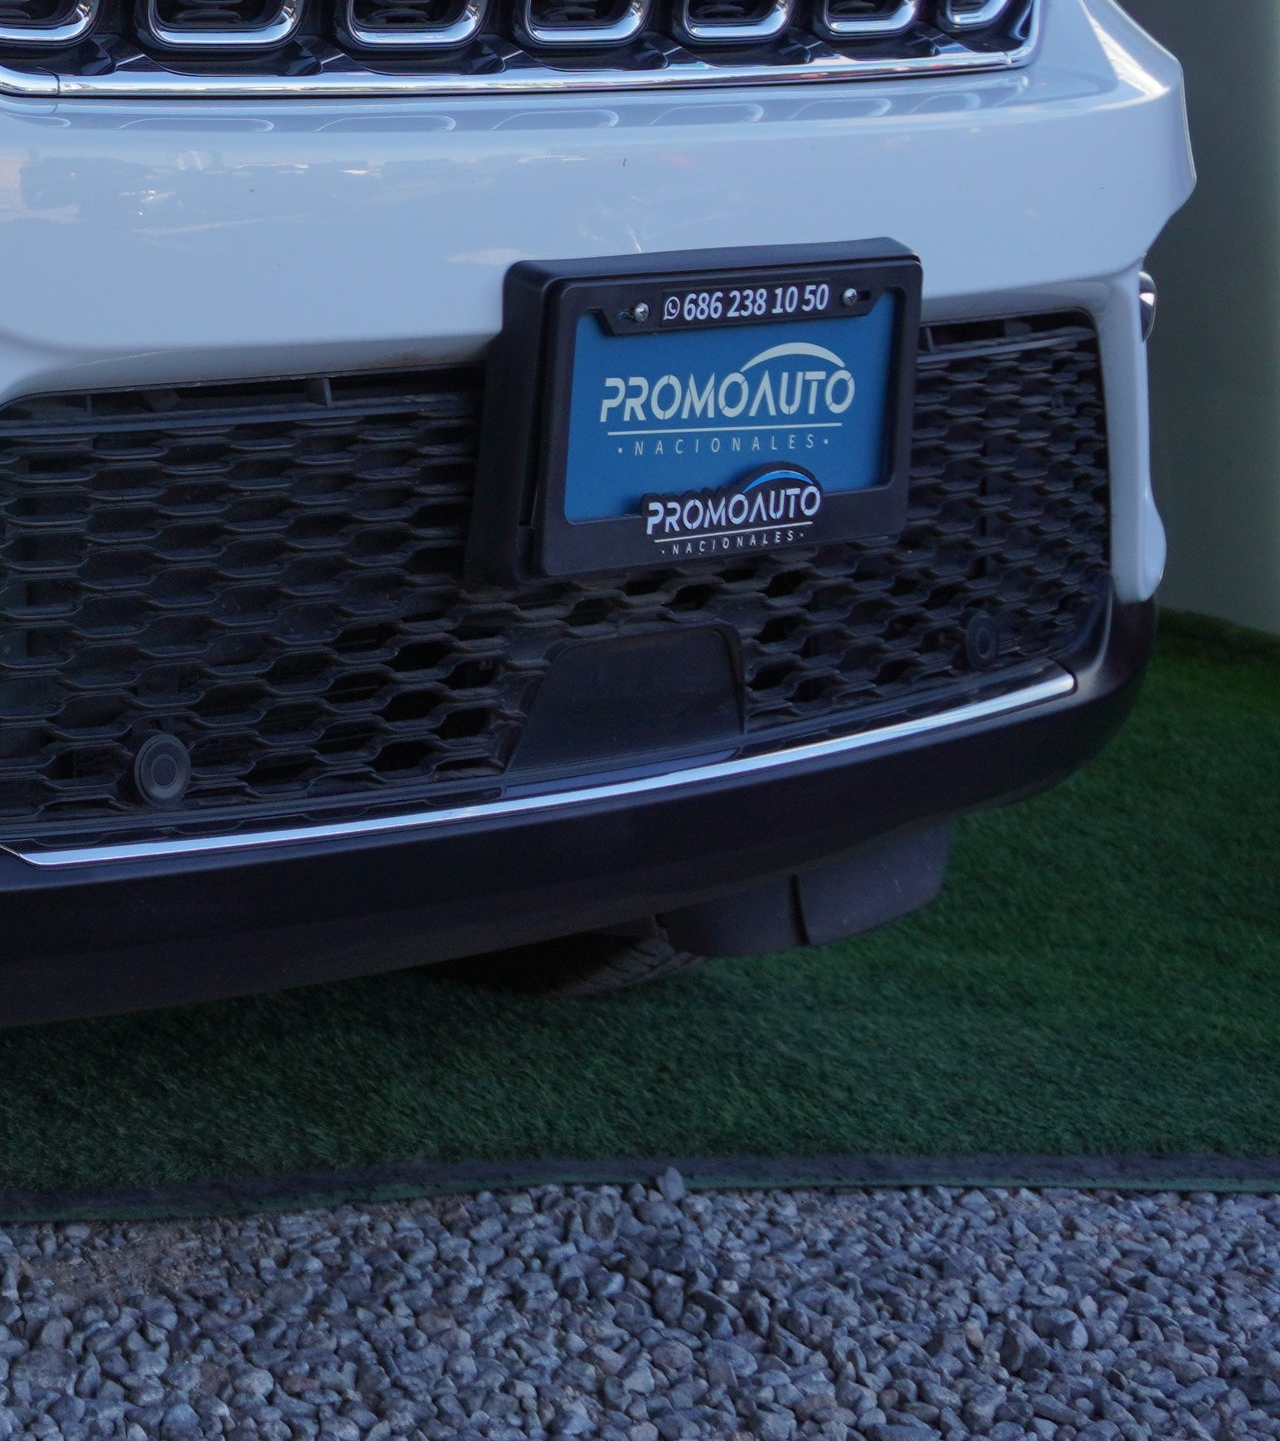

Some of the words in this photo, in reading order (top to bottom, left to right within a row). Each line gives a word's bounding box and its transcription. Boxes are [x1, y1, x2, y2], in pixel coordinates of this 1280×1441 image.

[683, 291, 724, 321] 686
[727, 288, 767, 318] 238
[771, 285, 799, 314] 10
[802, 283, 830, 312] 50
[600, 369, 856, 423] PROMOAUTO
[634, 433, 815, 456] NACIONALES
[646, 485, 821, 535] PROMOAUTO
[672, 530, 795, 555] NACIONALES
